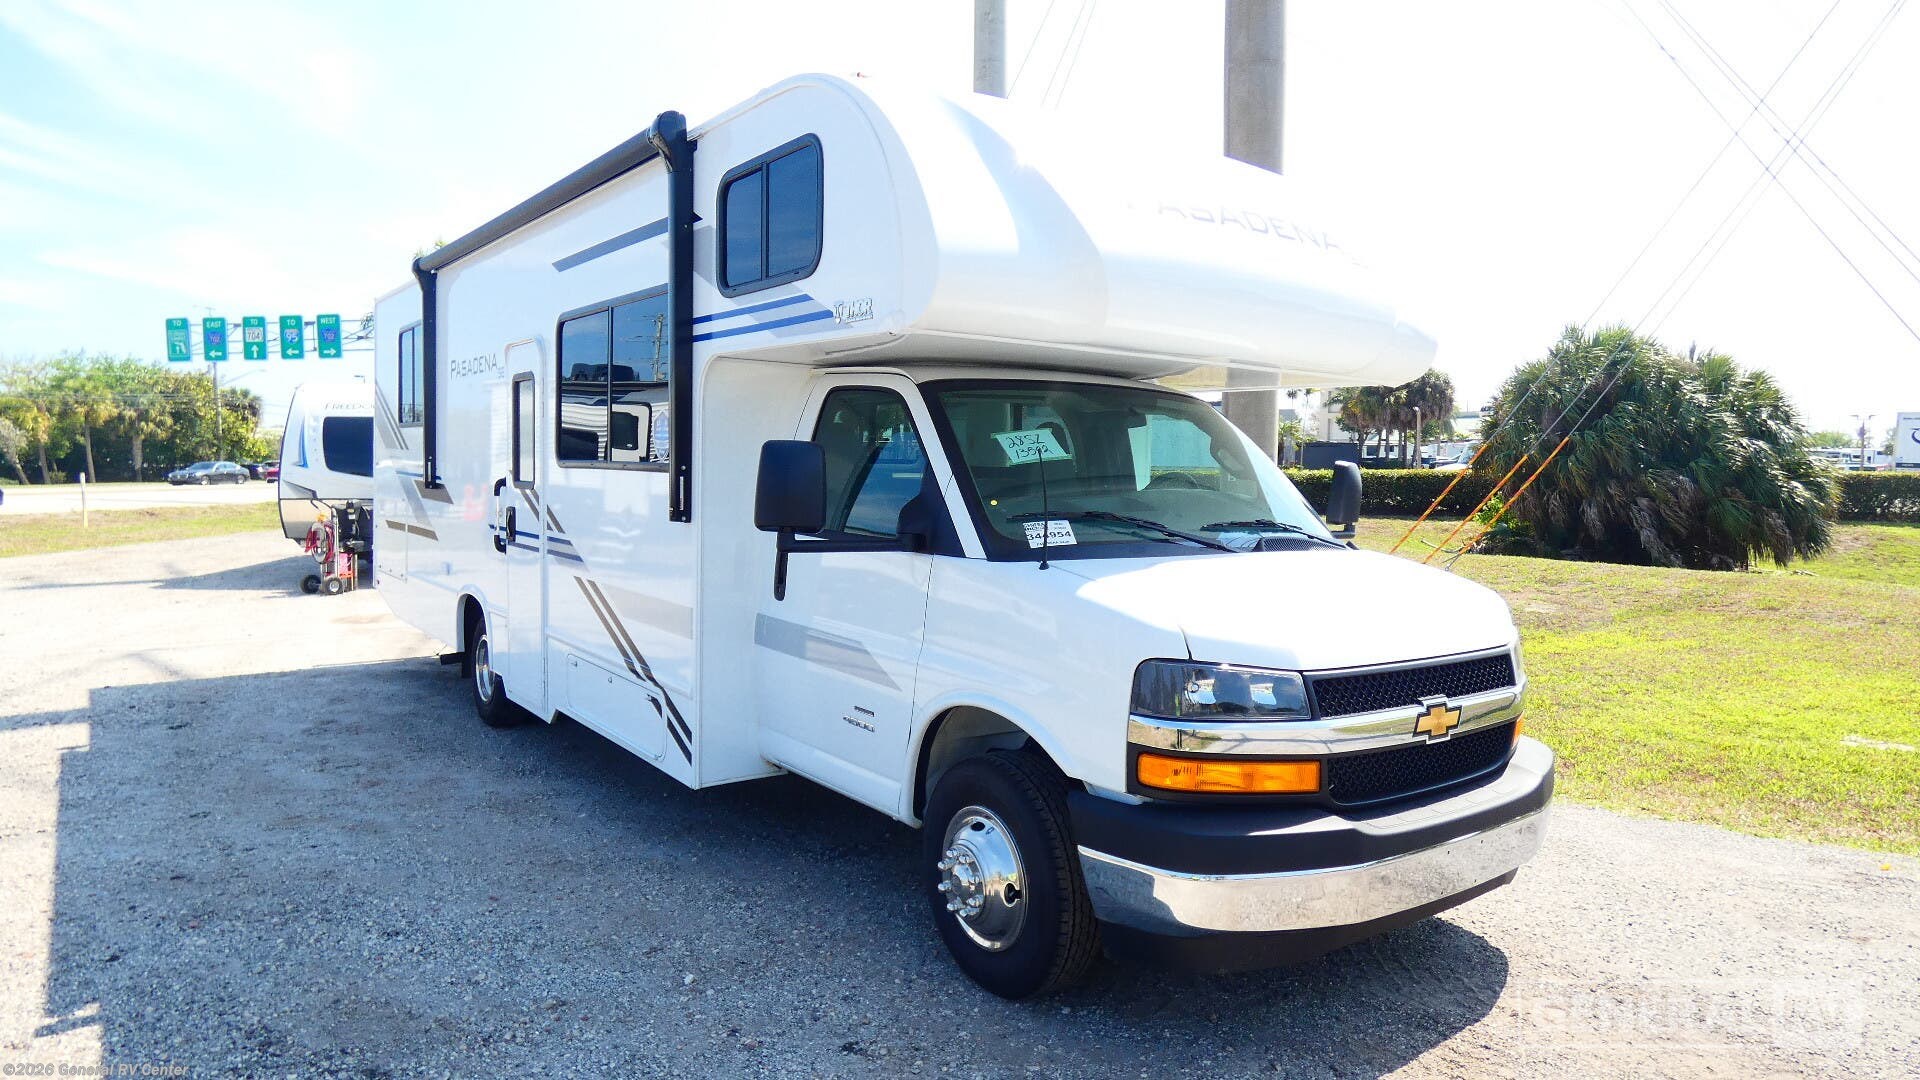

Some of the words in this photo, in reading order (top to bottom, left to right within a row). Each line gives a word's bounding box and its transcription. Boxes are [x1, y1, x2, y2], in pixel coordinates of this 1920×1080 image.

[1125, 200, 1344, 252] ASADENA
[172, 319, 182, 327] TO
[206, 320, 222, 328] EAST
[320, 317, 336, 325] WEST
[286, 331, 299, 343] 95
[451, 353, 497, 380] PASADENA
